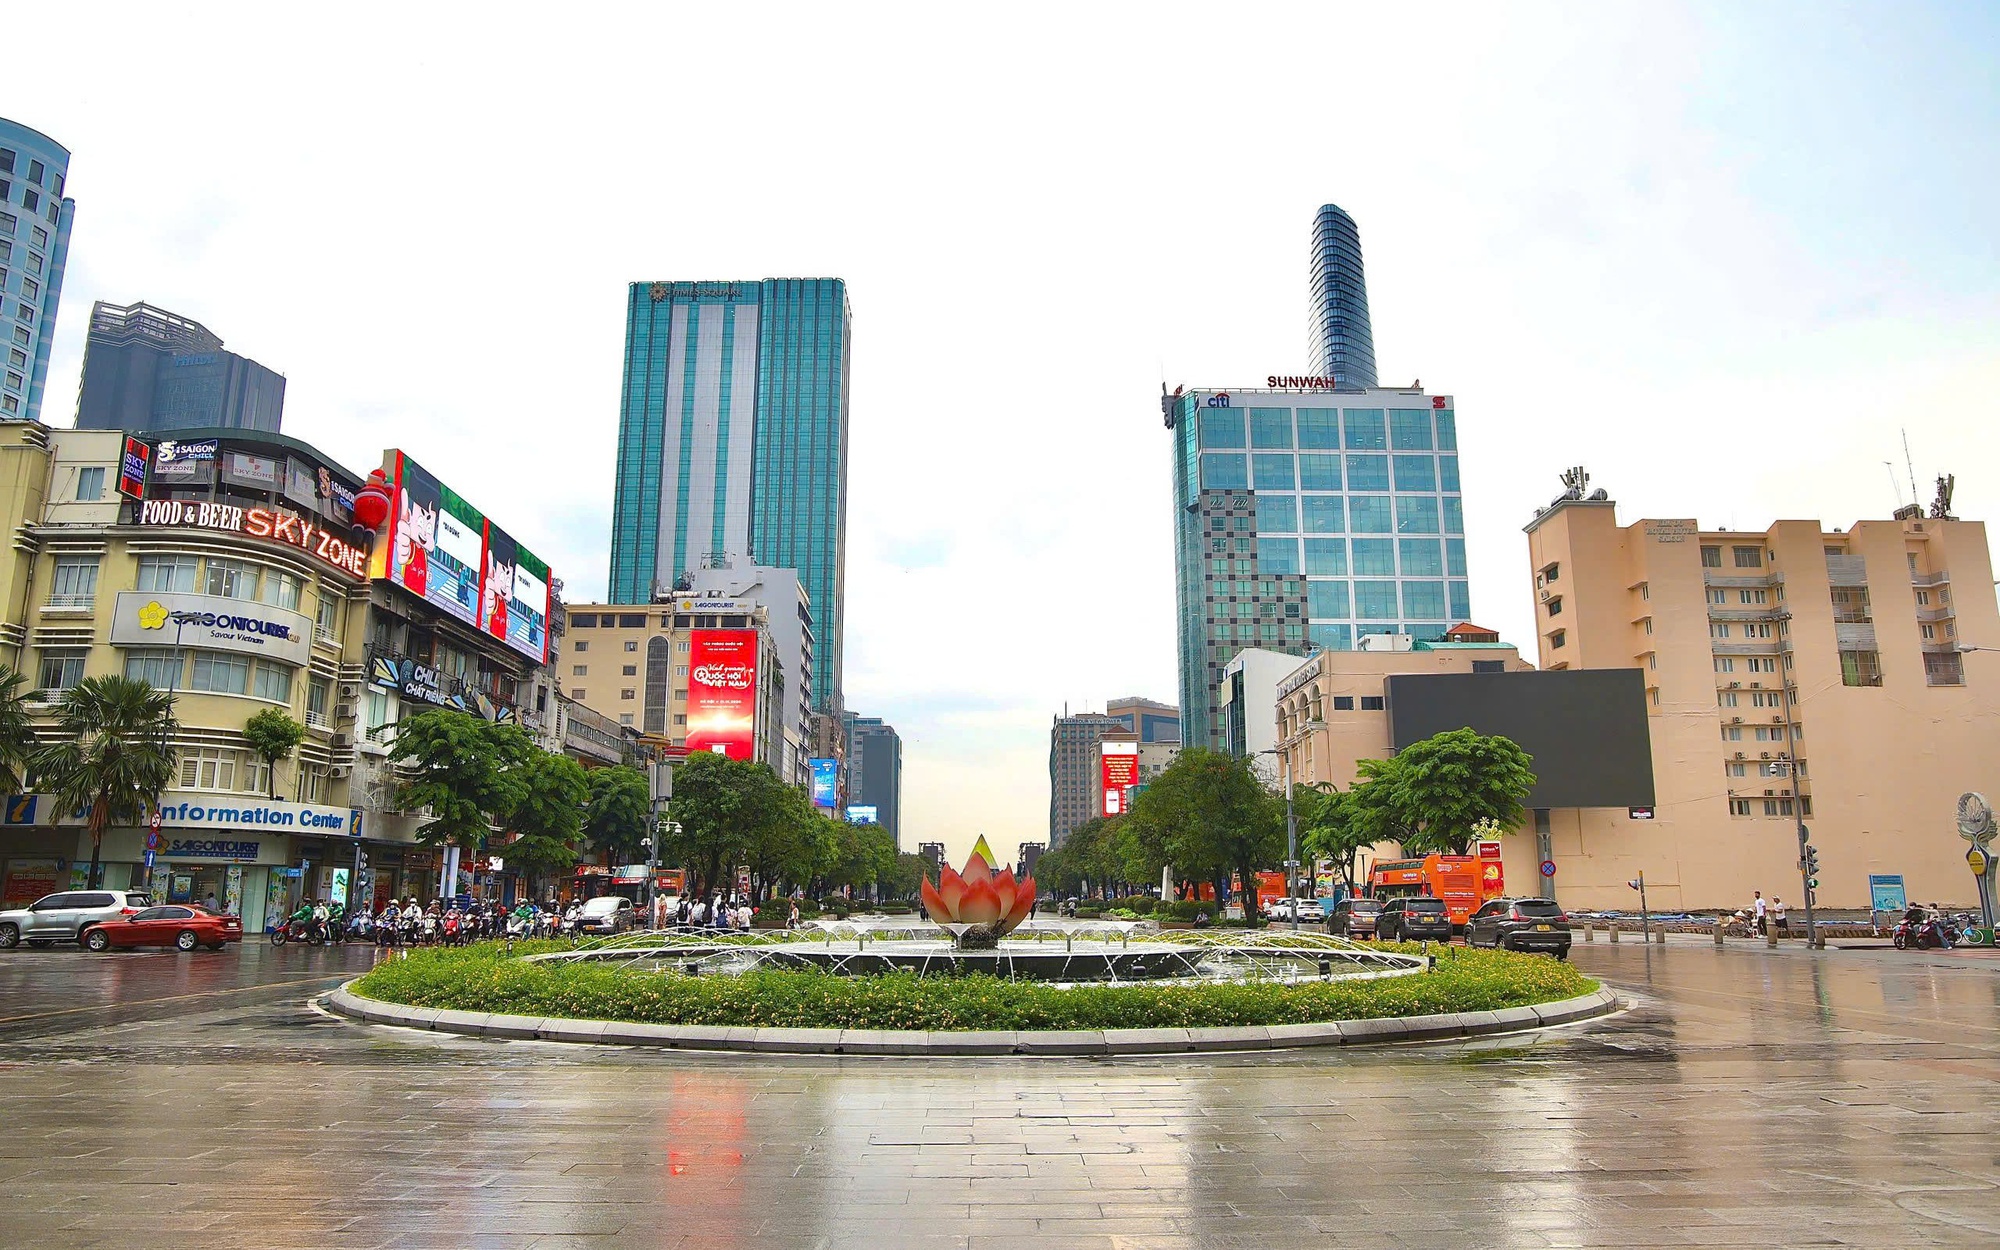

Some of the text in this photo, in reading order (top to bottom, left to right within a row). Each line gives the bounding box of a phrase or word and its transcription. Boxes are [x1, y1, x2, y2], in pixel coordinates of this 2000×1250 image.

[1267, 376, 1336, 388] SUNWAH
[208, 394, 230, 407] citi
[126, 453, 145, 469] SKY
[124, 464, 144, 478] ZONE
[251, 471, 274, 479] ZONE
[140, 501, 242, 531] FOOD & BEER
[244, 506, 367, 578] SKY ZONE
[170, 610, 290, 640] SAIGONTOURIST
[210, 630, 264, 645] Savour Vietnam
[414, 665, 440, 688] CHILL
[709, 679, 727, 688] VIỆT
[727, 672, 742, 681] HỘI
[405, 682, 446, 705] CHẤT RIÊNG
[299, 810, 344, 829] Center
[171, 839, 260, 853] SAIGONTOURIST
